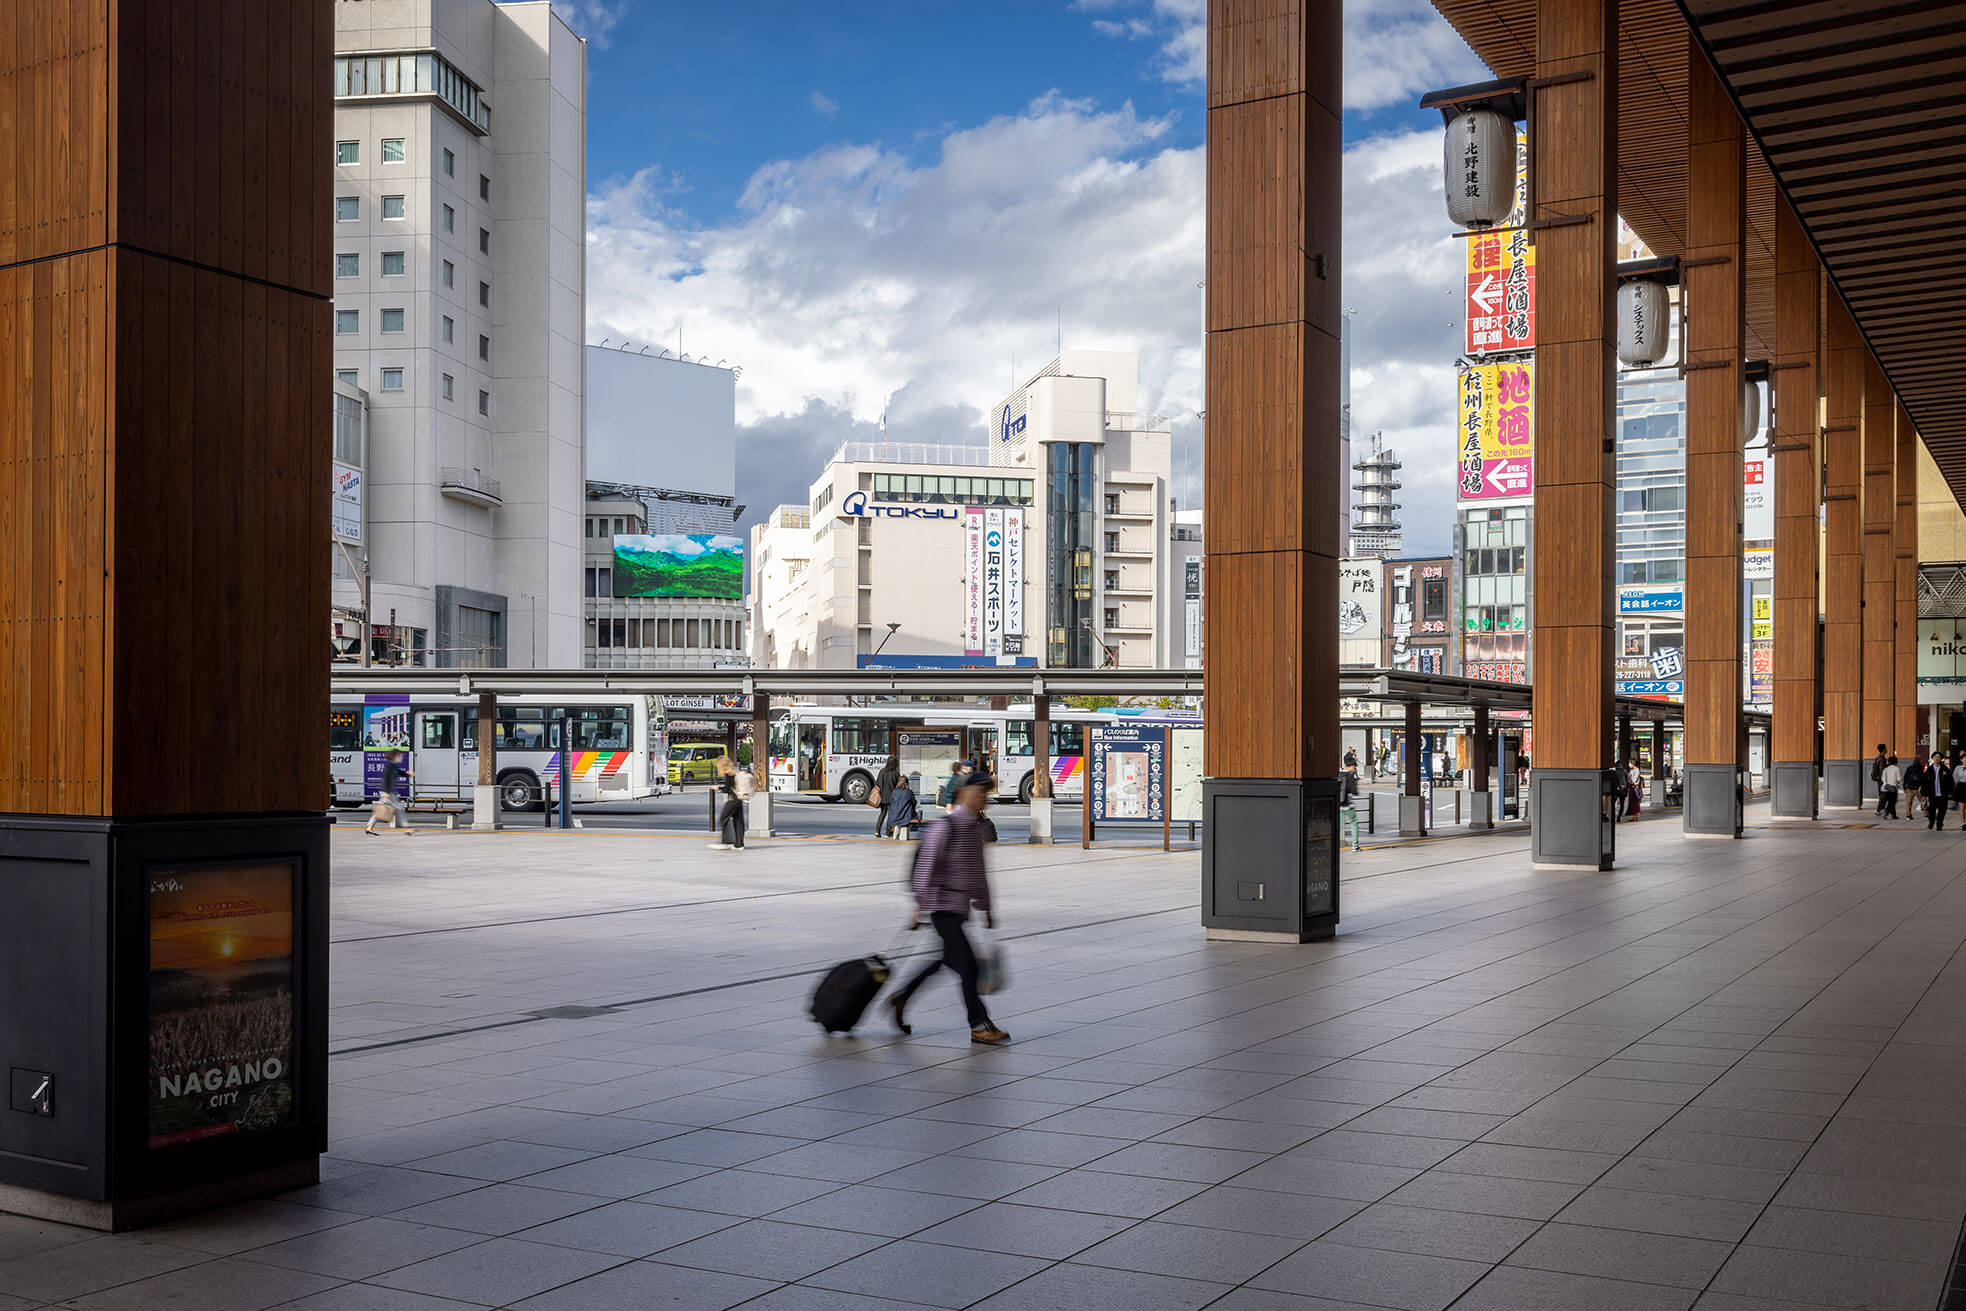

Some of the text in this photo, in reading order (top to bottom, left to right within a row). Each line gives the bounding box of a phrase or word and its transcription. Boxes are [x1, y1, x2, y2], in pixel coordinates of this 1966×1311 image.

[1464, 142, 1480, 198] 北野建設
[1472, 332, 1503, 346] 直進
[1497, 365, 1531, 447] 地酒
[1462, 371, 1483, 494] 信州長屋酒場
[340, 472, 351, 485] GYM
[343, 477, 360, 492] NASTA
[868, 505, 958, 520] TOKYU
[1008, 516, 1019, 630] 神戸セレクトマーケット
[987, 551, 1001, 633] 石井スポーツ
[1352, 578, 1375, 593] 戸隠
[1622, 599, 1681, 609] 英会話イーオン
[1393, 564, 1414, 664] ゴールデン
[1648, 646, 1682, 680] 歯
[330, 754, 352, 764] and
[367, 763, 385, 773] 長野
[159, 1057, 283, 1099] NAGANO
[209, 1090, 240, 1109] CITY
